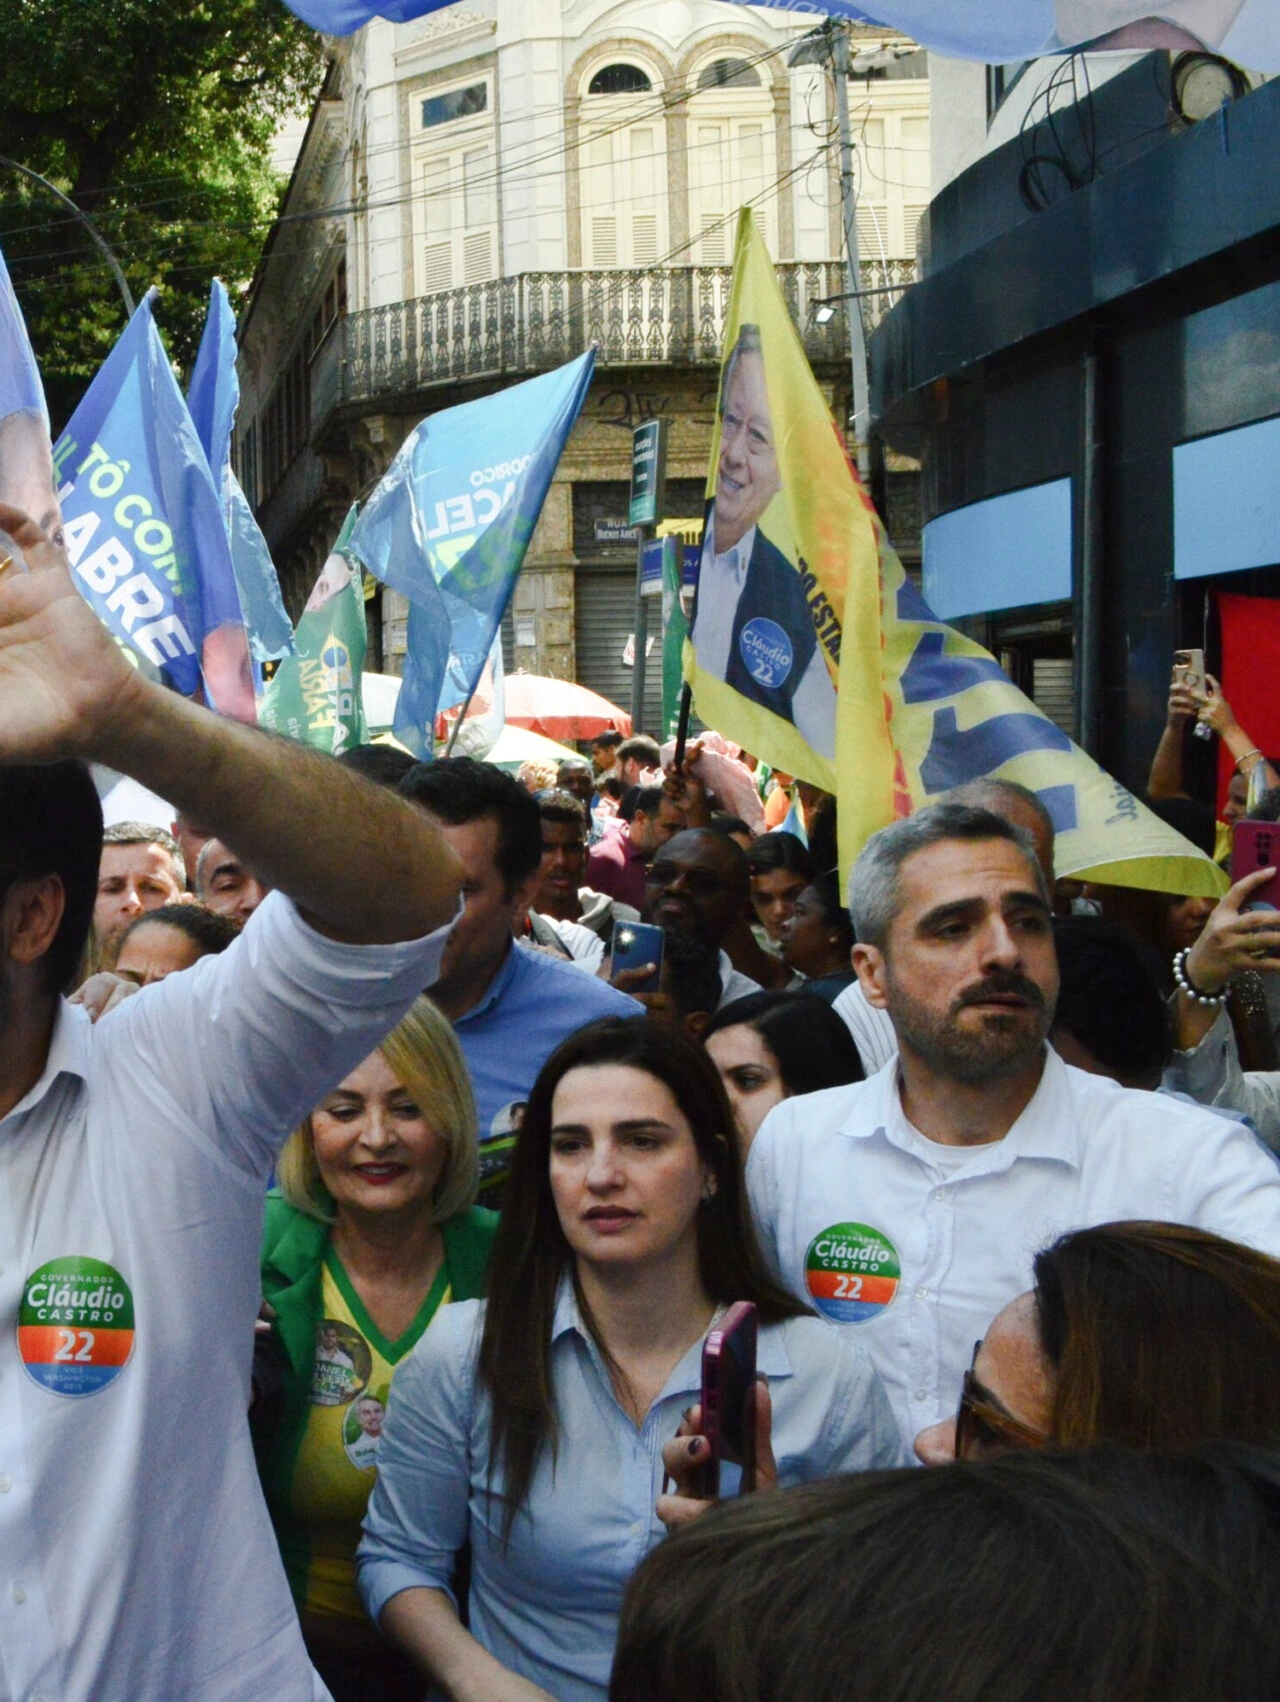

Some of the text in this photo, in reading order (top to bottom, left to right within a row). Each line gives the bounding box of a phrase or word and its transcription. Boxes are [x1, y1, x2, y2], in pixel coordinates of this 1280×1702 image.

[77, 441, 131, 499] TÔ
[59, 482, 196, 667] ABRE
[742, 629, 791, 667] Cláudio
[752, 658, 774, 684] 22
[815, 1240, 890, 1262] Cláudio
[822, 1258, 879, 1271] CASTRO
[40, 1274, 114, 1283] GOVERNADOR
[833, 1275, 863, 1299] 22
[27, 1283, 124, 1309] Cláudio
[37, 1308, 113, 1322] CASTRO
[55, 1330, 95, 1361] 22
